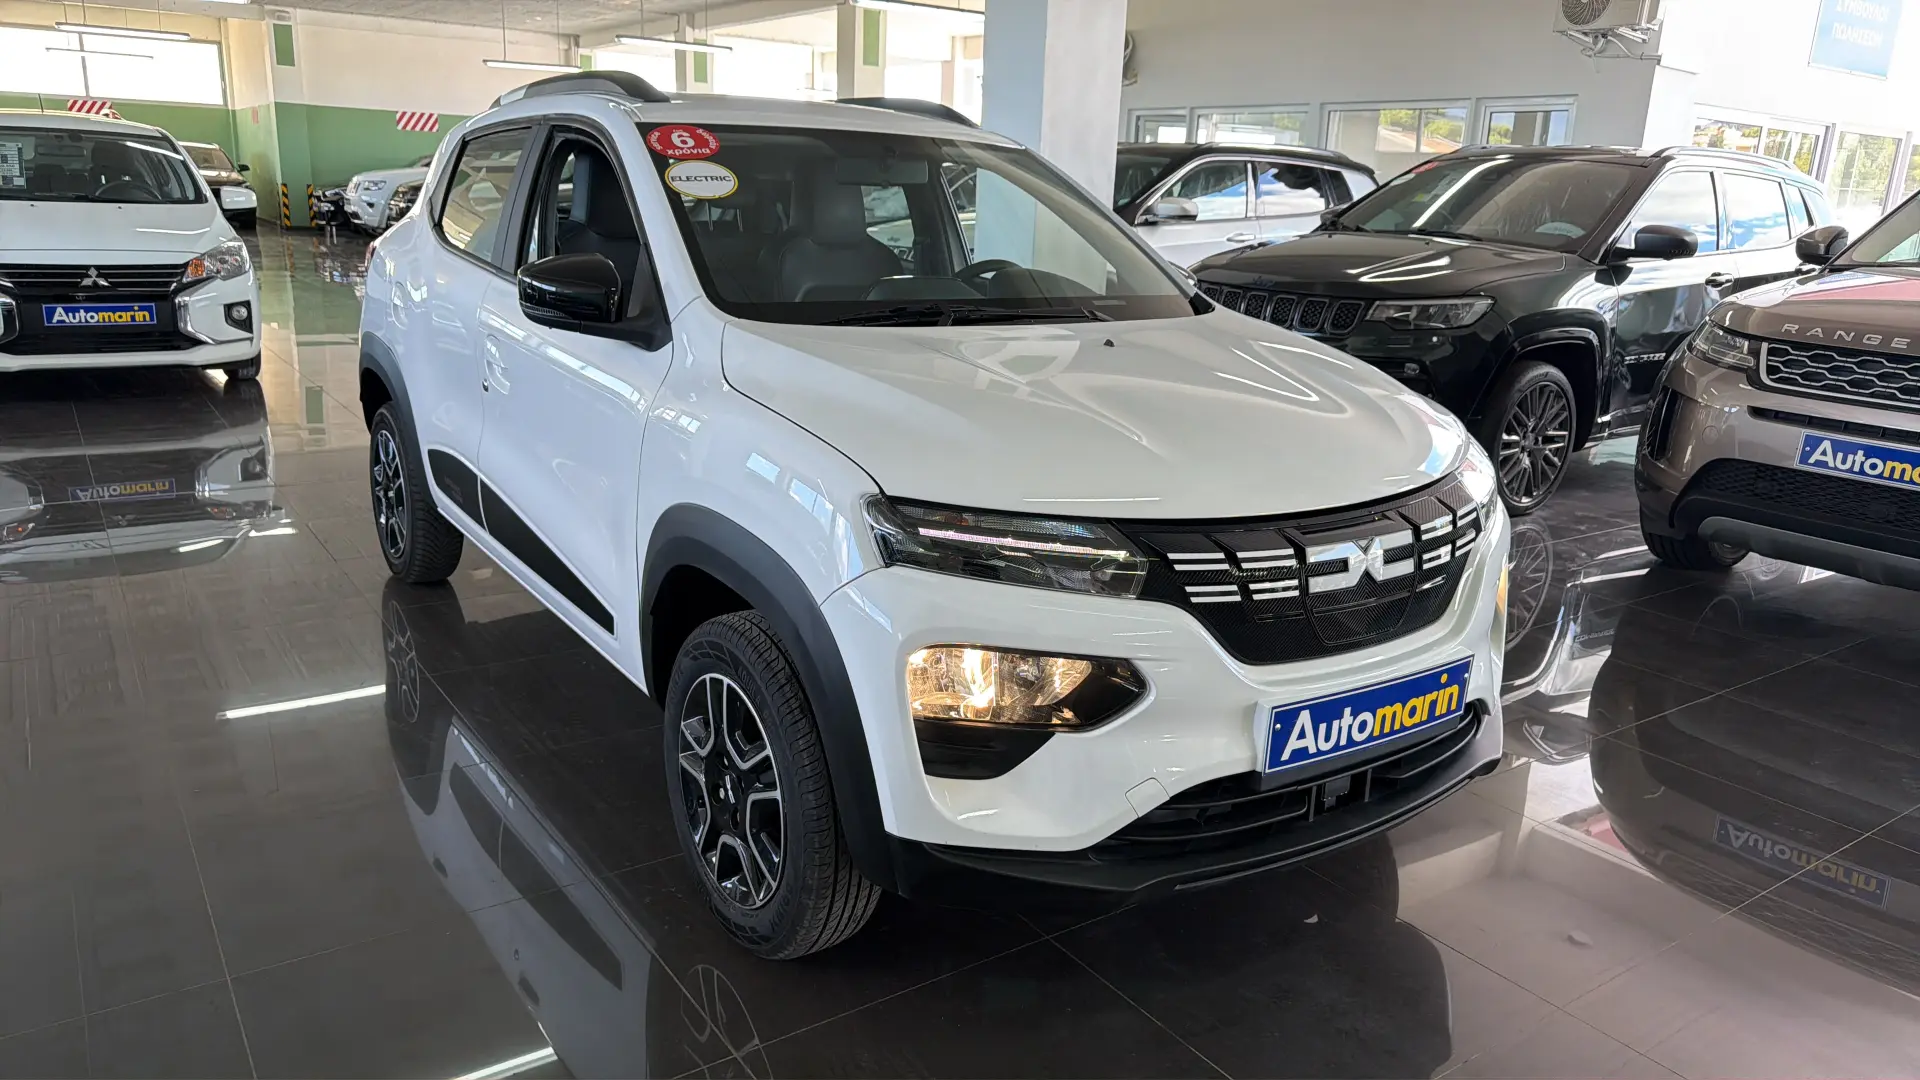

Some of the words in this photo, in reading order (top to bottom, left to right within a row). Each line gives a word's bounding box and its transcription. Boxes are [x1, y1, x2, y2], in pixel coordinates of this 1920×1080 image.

[671, 131, 695, 148] 6
[666, 147, 711, 156] χρόνια
[670, 175, 732, 183] ELECTRIC
[51, 305, 151, 324] Automarin
[1780, 323, 1911, 350] RANGE
[1279, 672, 1460, 762] Automarin
